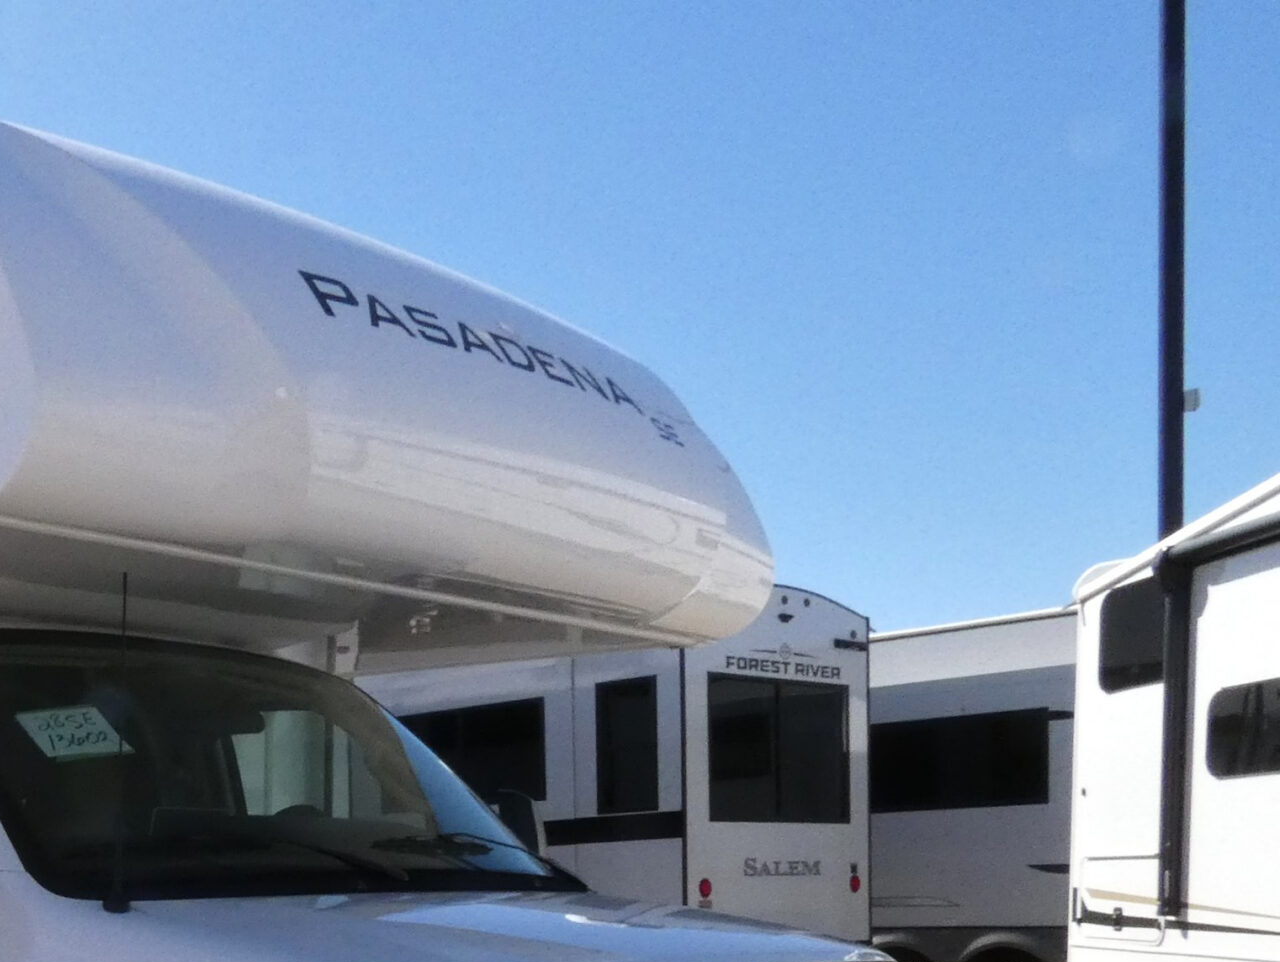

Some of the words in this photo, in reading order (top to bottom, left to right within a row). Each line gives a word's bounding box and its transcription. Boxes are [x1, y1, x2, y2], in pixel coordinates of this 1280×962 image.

[297, 269, 646, 416] PASADENA
[725, 655, 790, 676] FOREST
[794, 663, 841, 680] RIVER
[743, 857, 822, 877] SALEM
